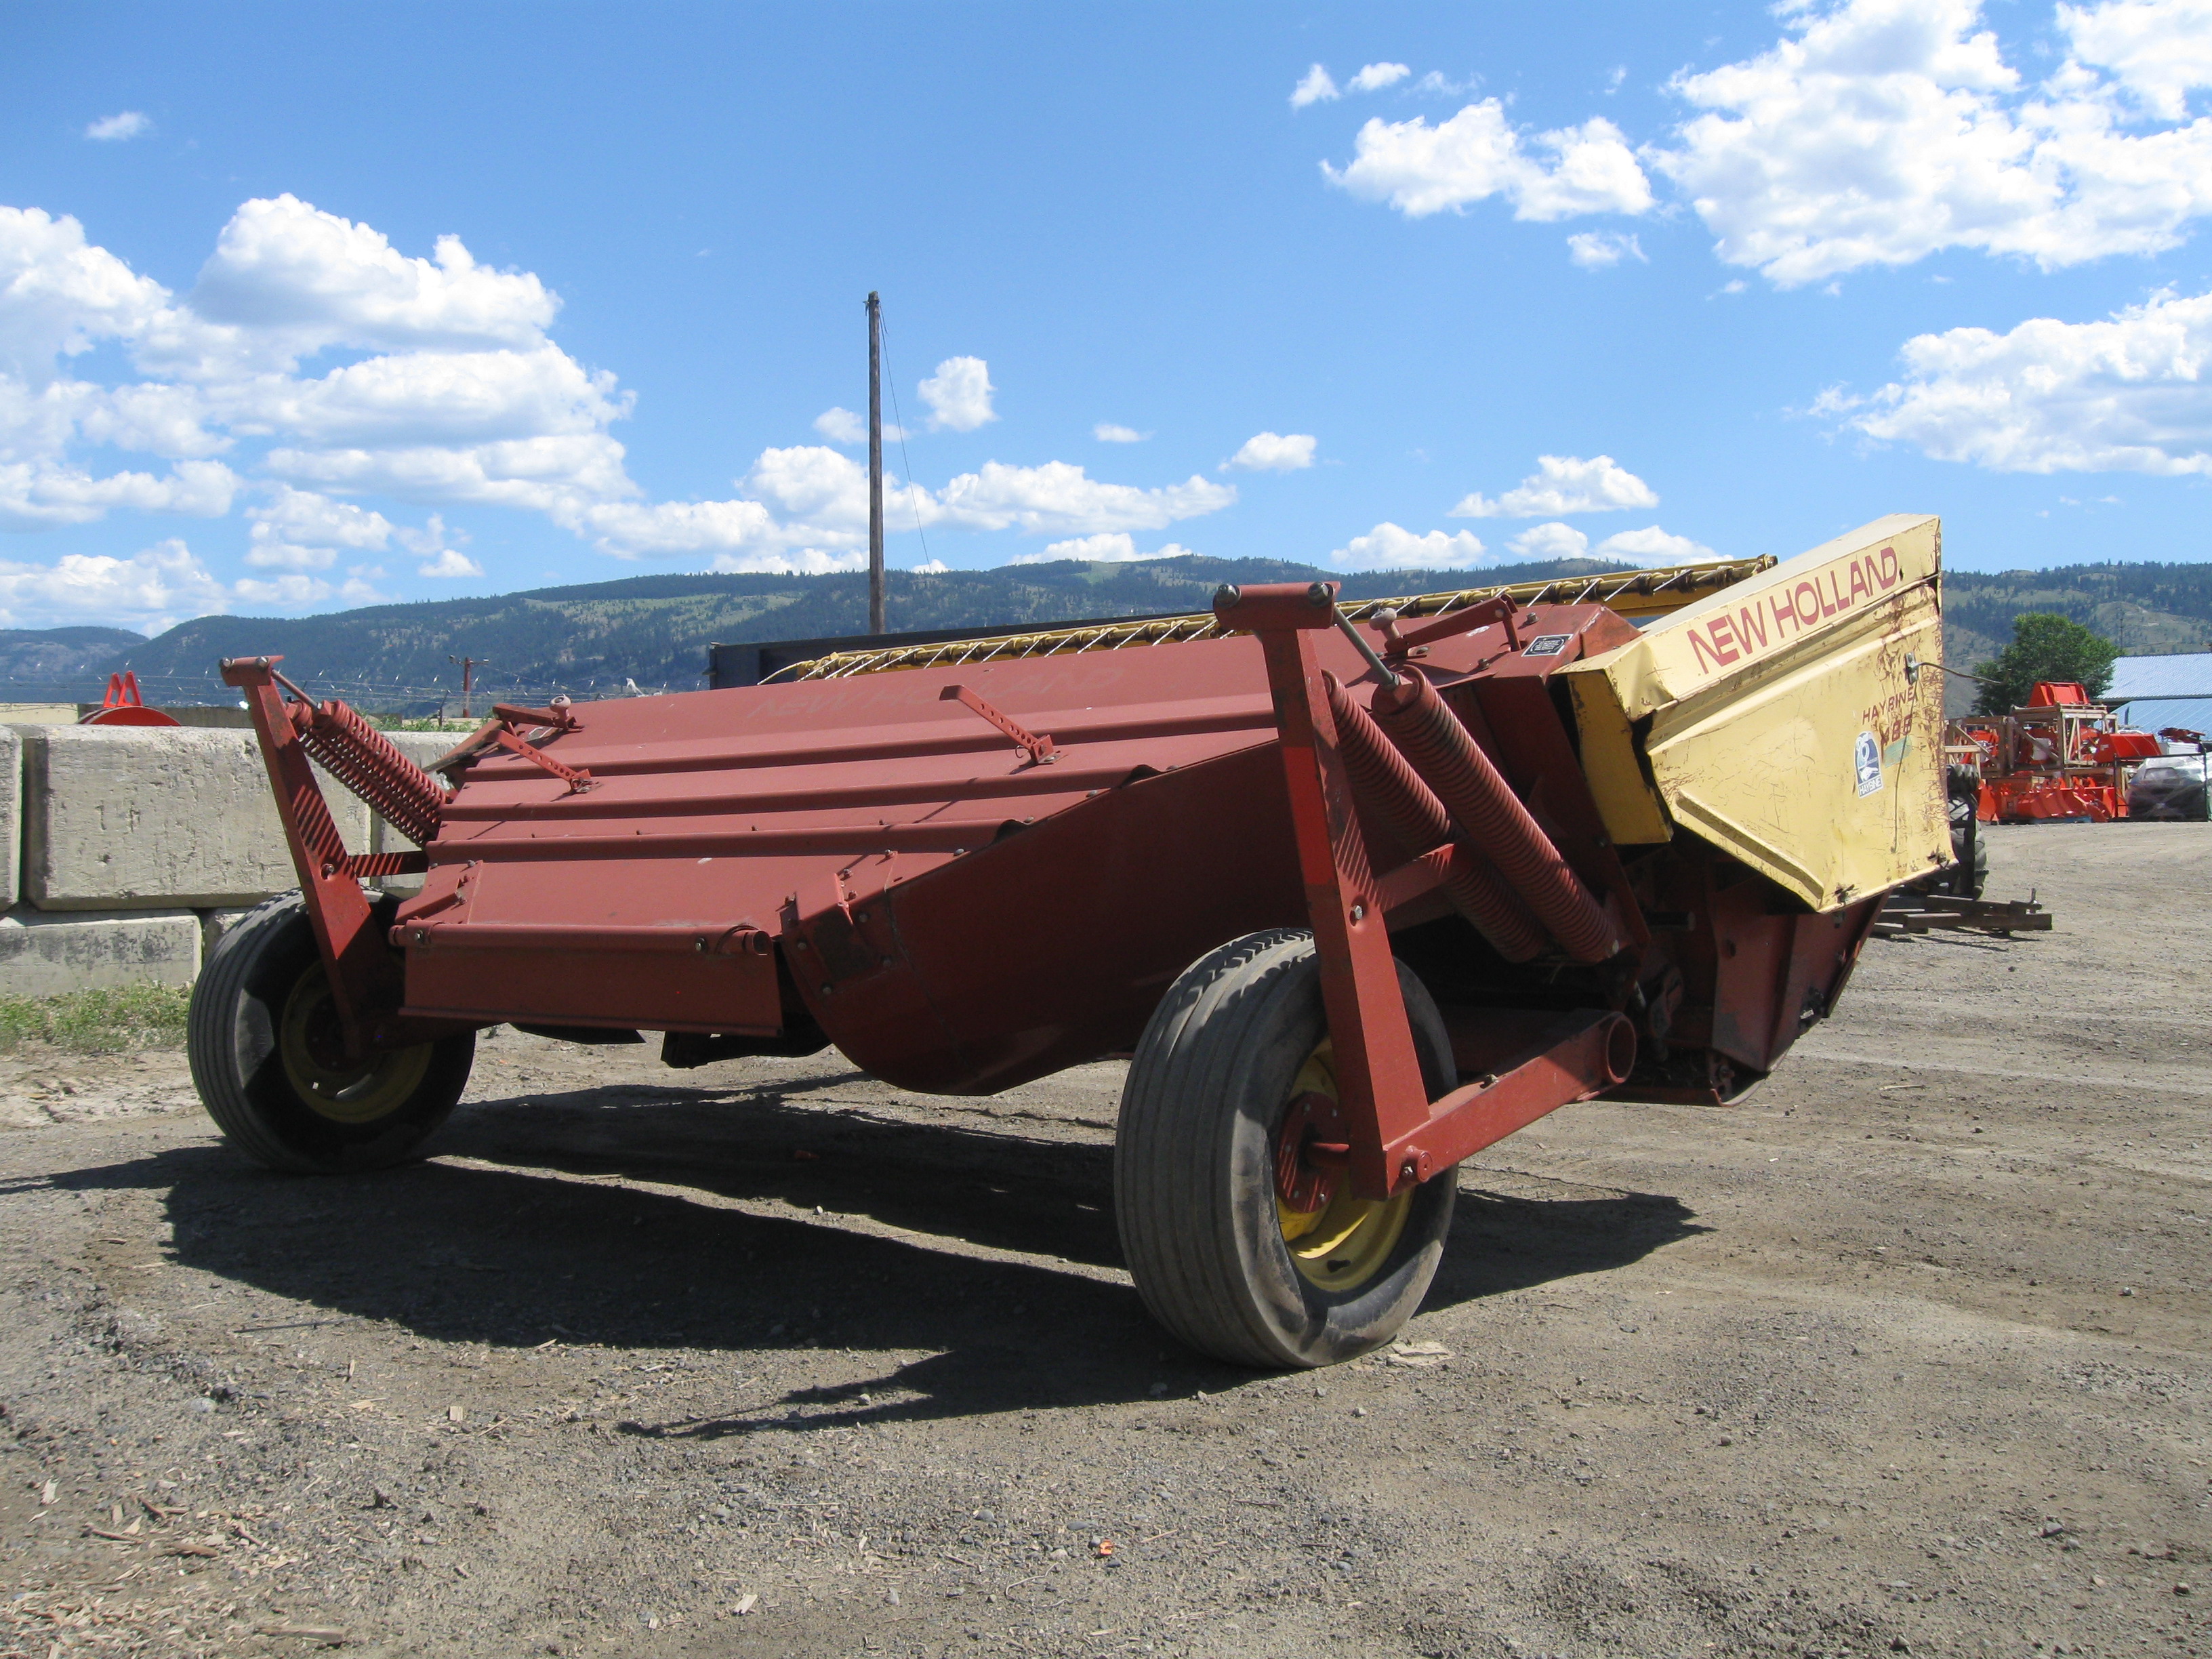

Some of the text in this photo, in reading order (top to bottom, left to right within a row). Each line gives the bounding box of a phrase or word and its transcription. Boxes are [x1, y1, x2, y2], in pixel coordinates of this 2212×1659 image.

[1687, 546, 1898, 675] NEW HOLLAND
[1862, 686, 1915, 725] HAYBINE
[1859, 777, 1882, 796] HAYBINE
